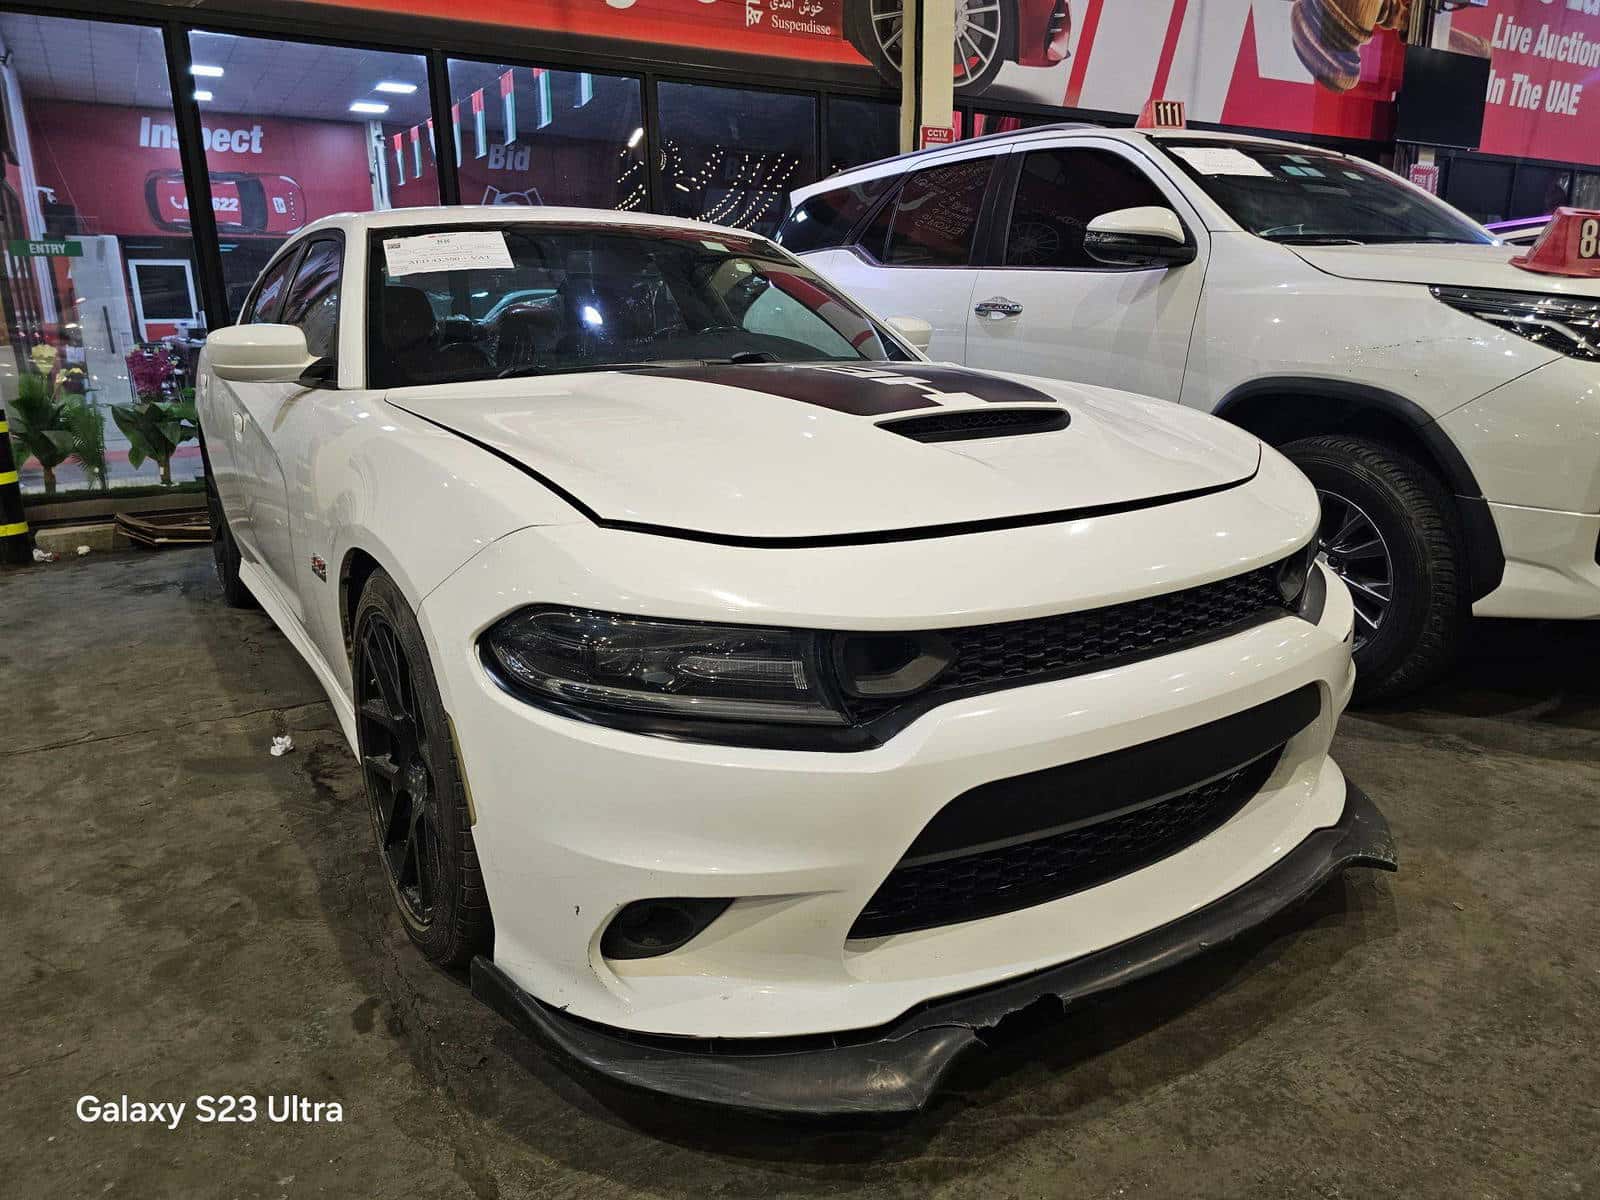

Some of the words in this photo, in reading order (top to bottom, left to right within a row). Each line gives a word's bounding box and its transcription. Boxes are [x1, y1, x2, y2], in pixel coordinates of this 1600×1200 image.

[771, 14, 832, 36] Suspendisse
[1491, 13, 1533, 54] Live
[1533, 24, 1600, 68] Auction
[1485, 69, 1506, 105] In
[1509, 72, 1543, 110] The
[1545, 79, 1584, 116] UAE
[1158, 102, 1180, 126] 111
[139, 116, 264, 154] Inect
[927, 129, 948, 138] CCTV
[488, 143, 531, 171] Bid
[28, 243, 66, 255] ENTRY
[1580, 219, 1600, 258] 8
